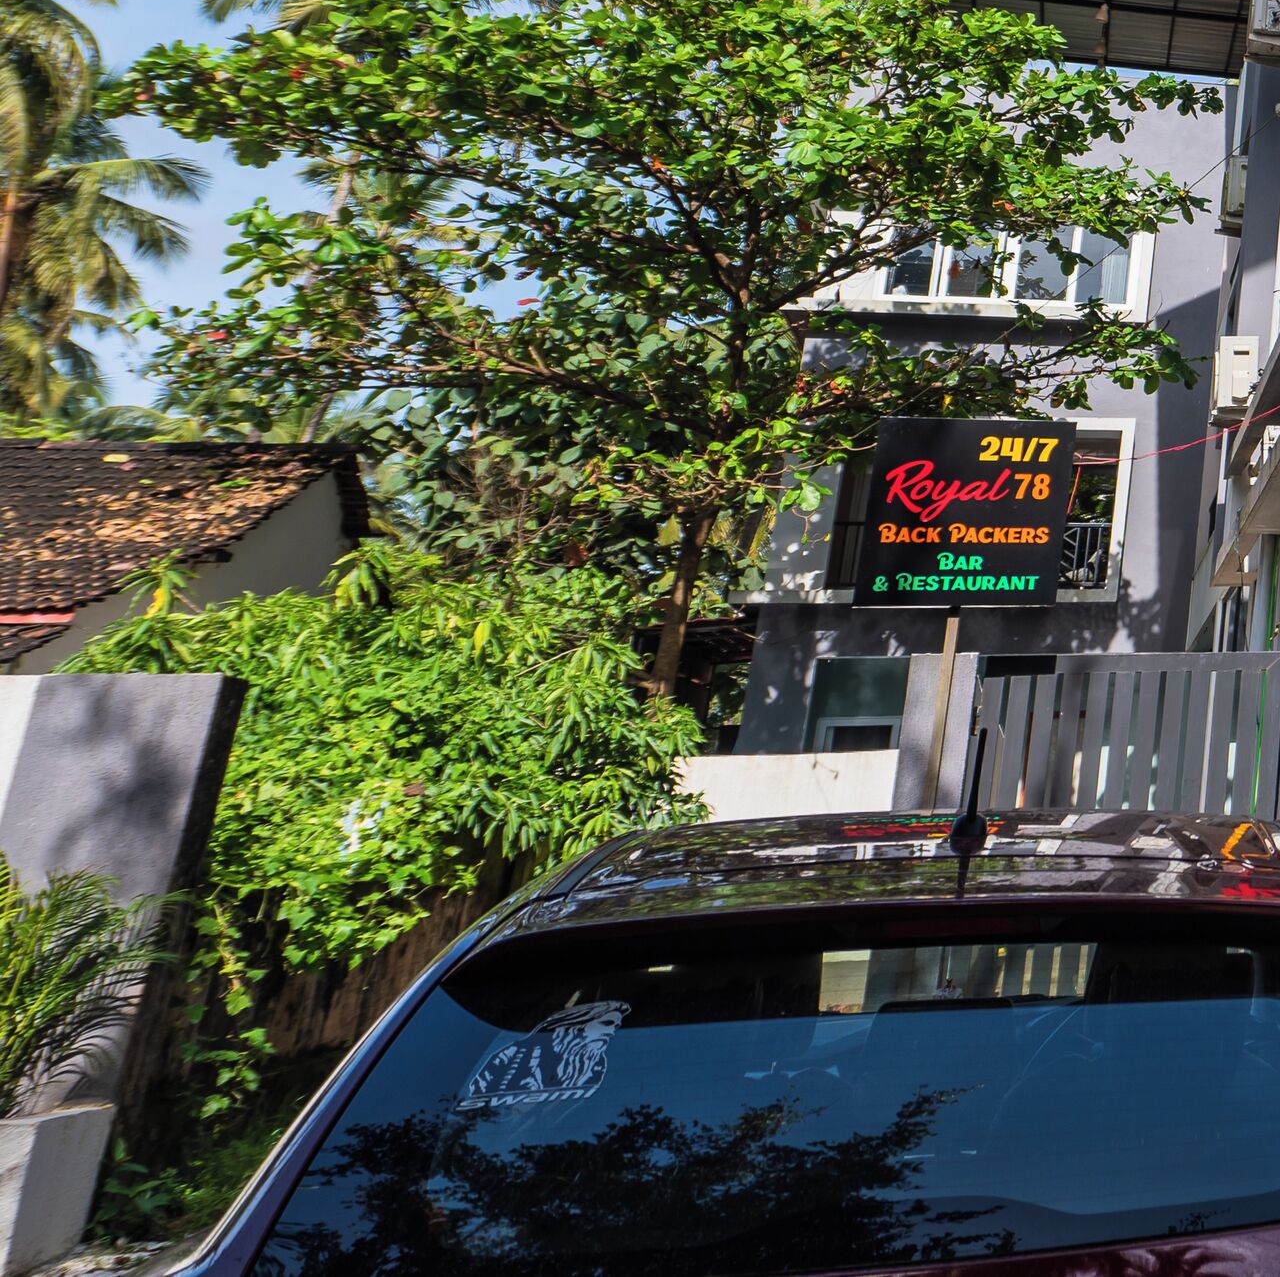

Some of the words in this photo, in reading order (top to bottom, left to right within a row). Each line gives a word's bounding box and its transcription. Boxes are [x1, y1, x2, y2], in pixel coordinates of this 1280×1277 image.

[979, 436, 1059, 462] 24/7
[885, 460, 1012, 522] Royal
[1014, 474, 1050, 499] 78
[878, 523, 942, 543] BACK
[948, 523, 1049, 544] PACKERS
[937, 552, 983, 570] BAR
[872, 576, 888, 592] &
[896, 573, 1039, 591] RESTAURANT
